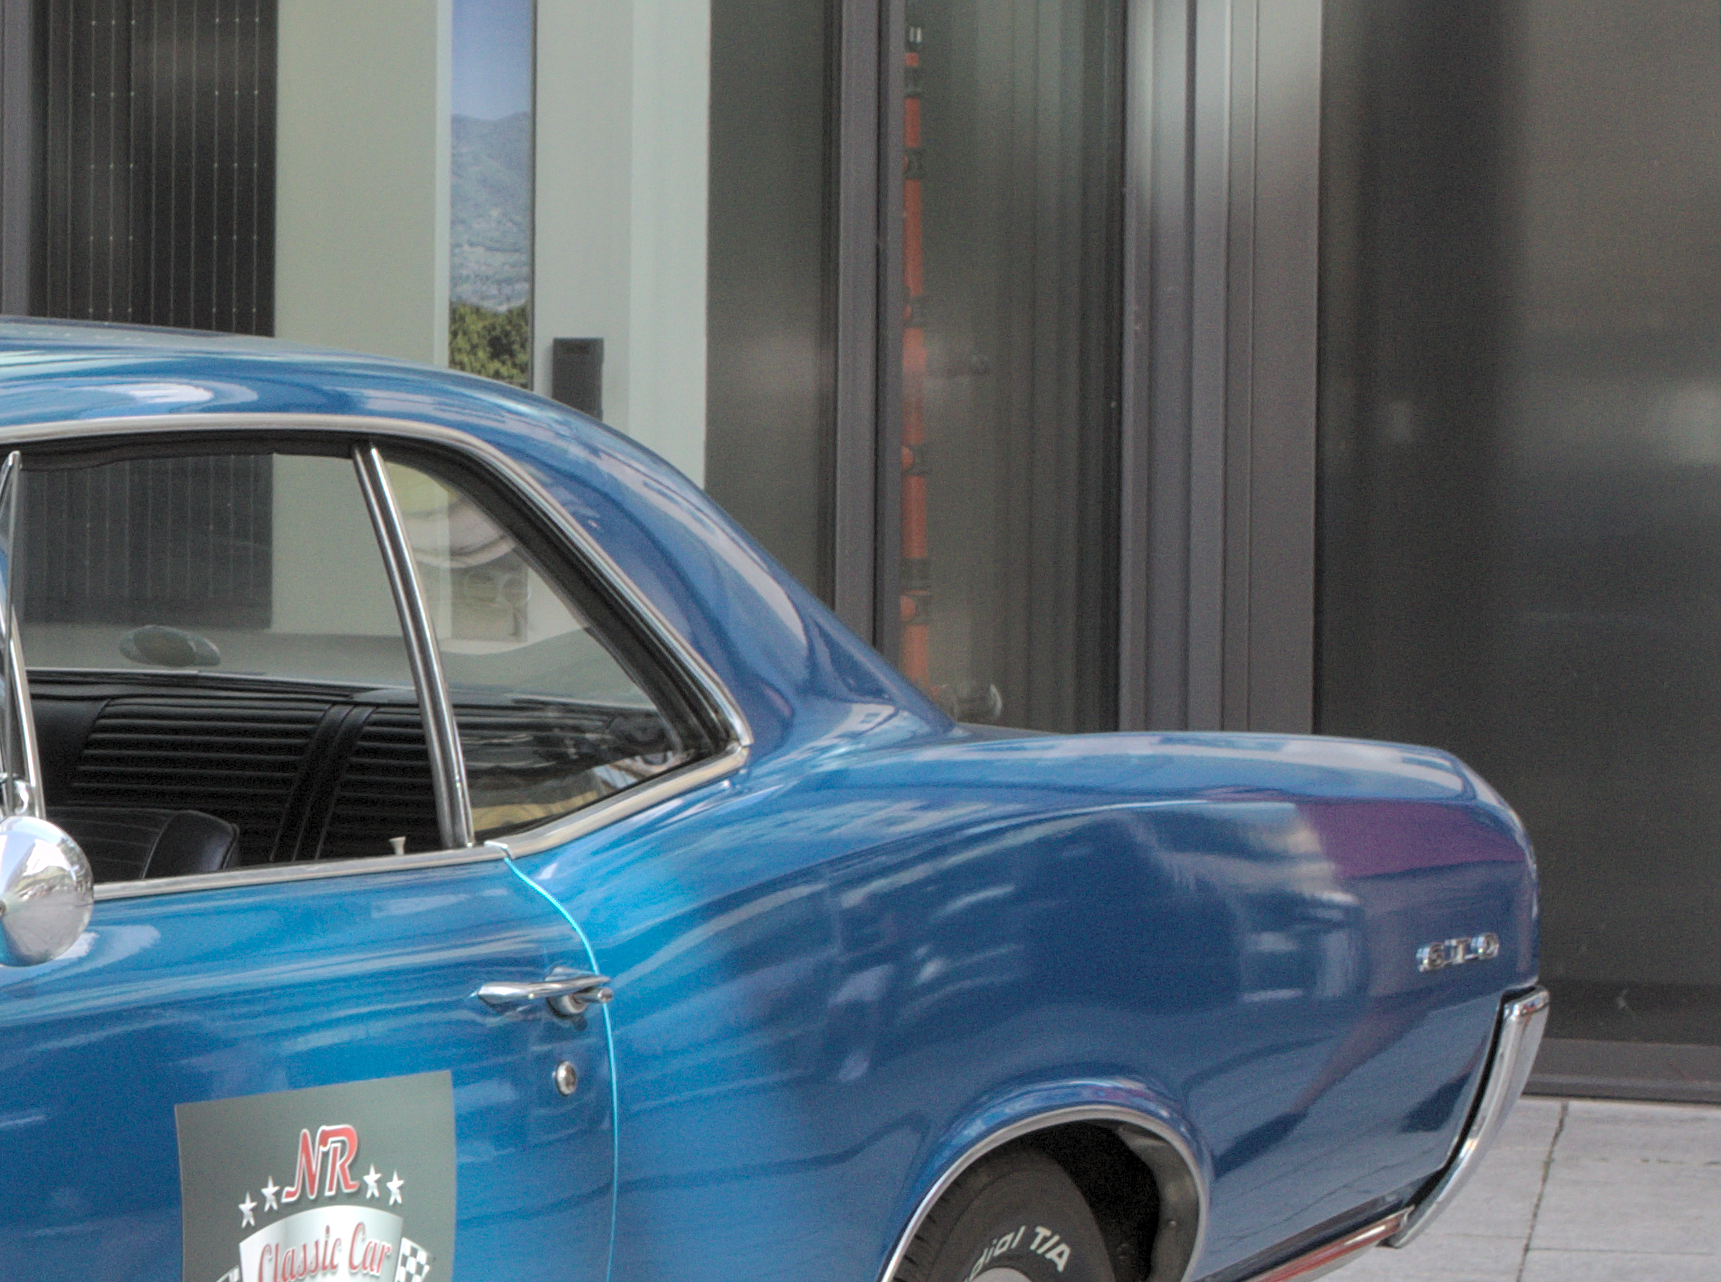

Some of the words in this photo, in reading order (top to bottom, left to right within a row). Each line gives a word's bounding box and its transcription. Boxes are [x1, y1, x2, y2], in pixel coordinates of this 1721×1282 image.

[281, 1124, 360, 1203] NR
[348, 1222, 392, 1278] Car
[1029, 1225, 1071, 1273] T/A
